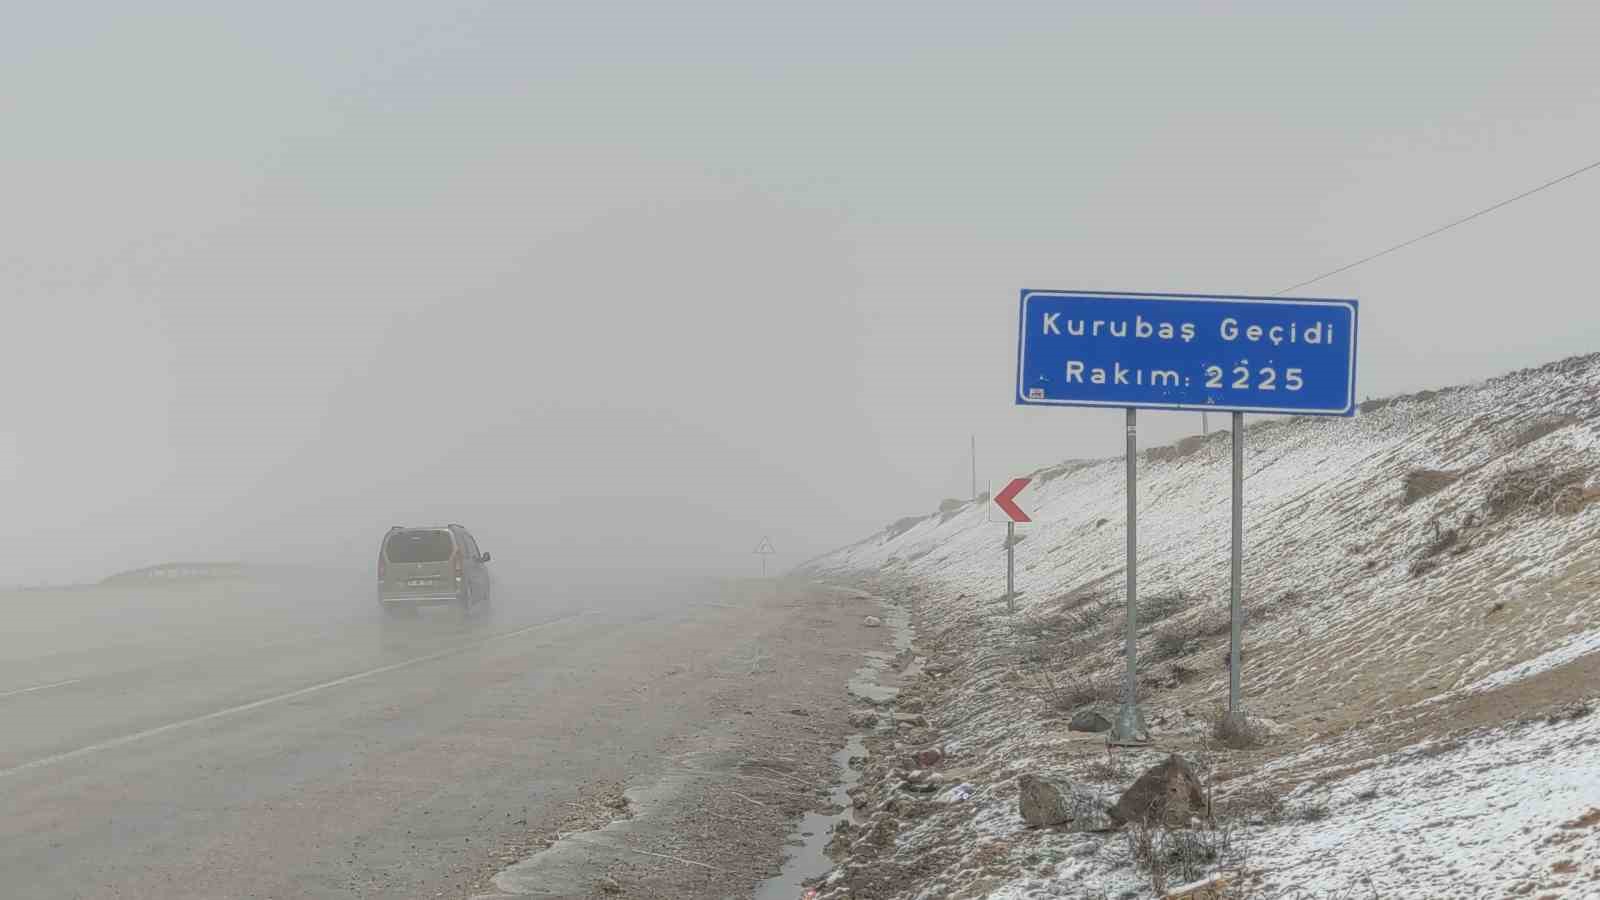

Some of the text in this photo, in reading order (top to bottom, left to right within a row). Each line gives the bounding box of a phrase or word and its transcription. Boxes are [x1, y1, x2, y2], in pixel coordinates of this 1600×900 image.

[1043, 312, 1333, 346] Kurubaş Geçidi
[1066, 360, 1303, 391] Rakım: 2225
